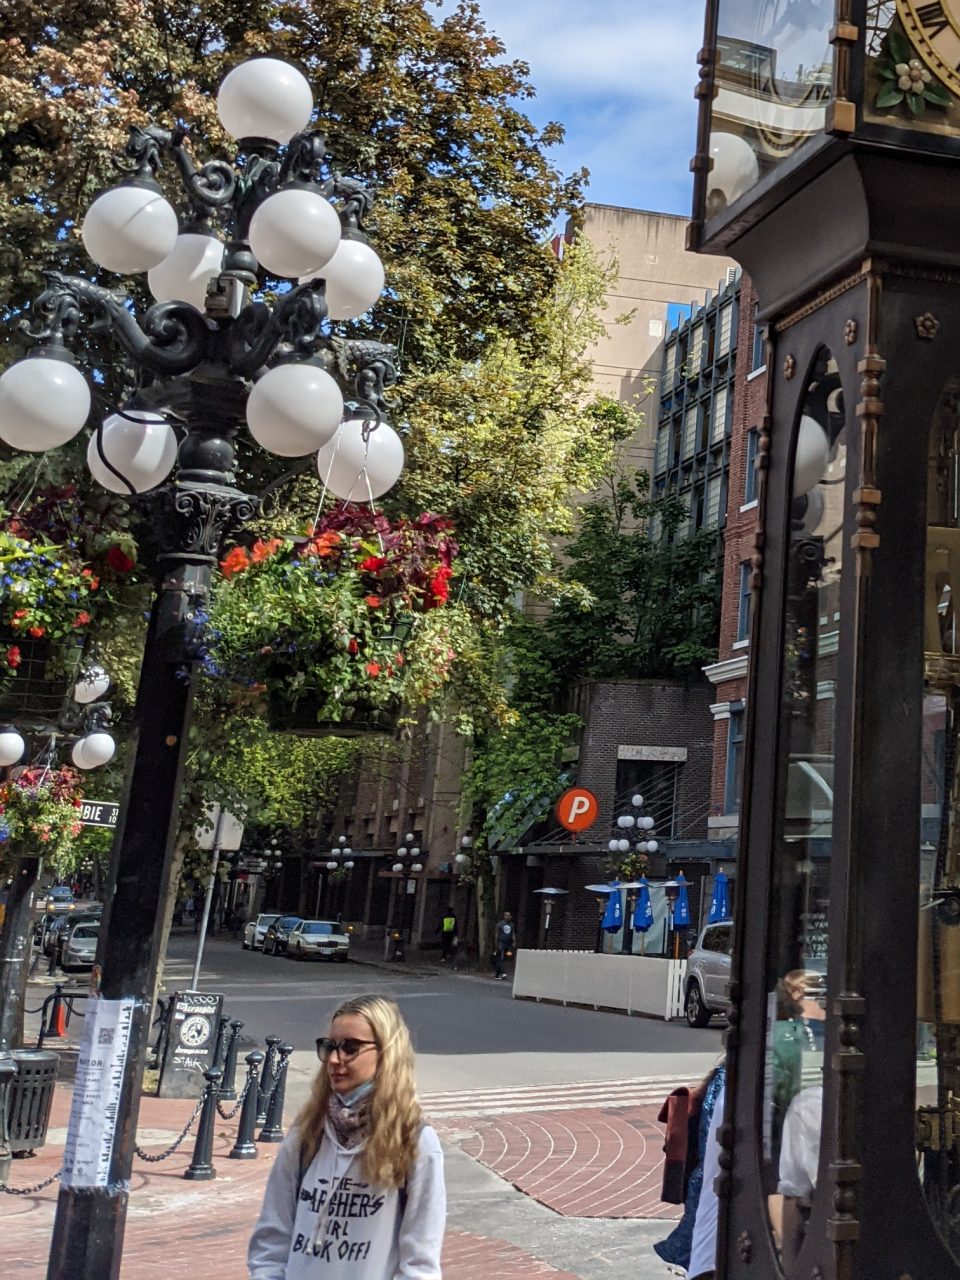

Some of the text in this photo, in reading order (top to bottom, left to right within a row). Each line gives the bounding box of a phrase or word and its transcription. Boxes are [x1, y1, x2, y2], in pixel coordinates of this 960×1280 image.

[81, 804, 104, 821] BIE
[568, 796, 590, 824] P
[325, 1219, 349, 1240] IRL
[337, 1239, 371, 1262] OFF!
